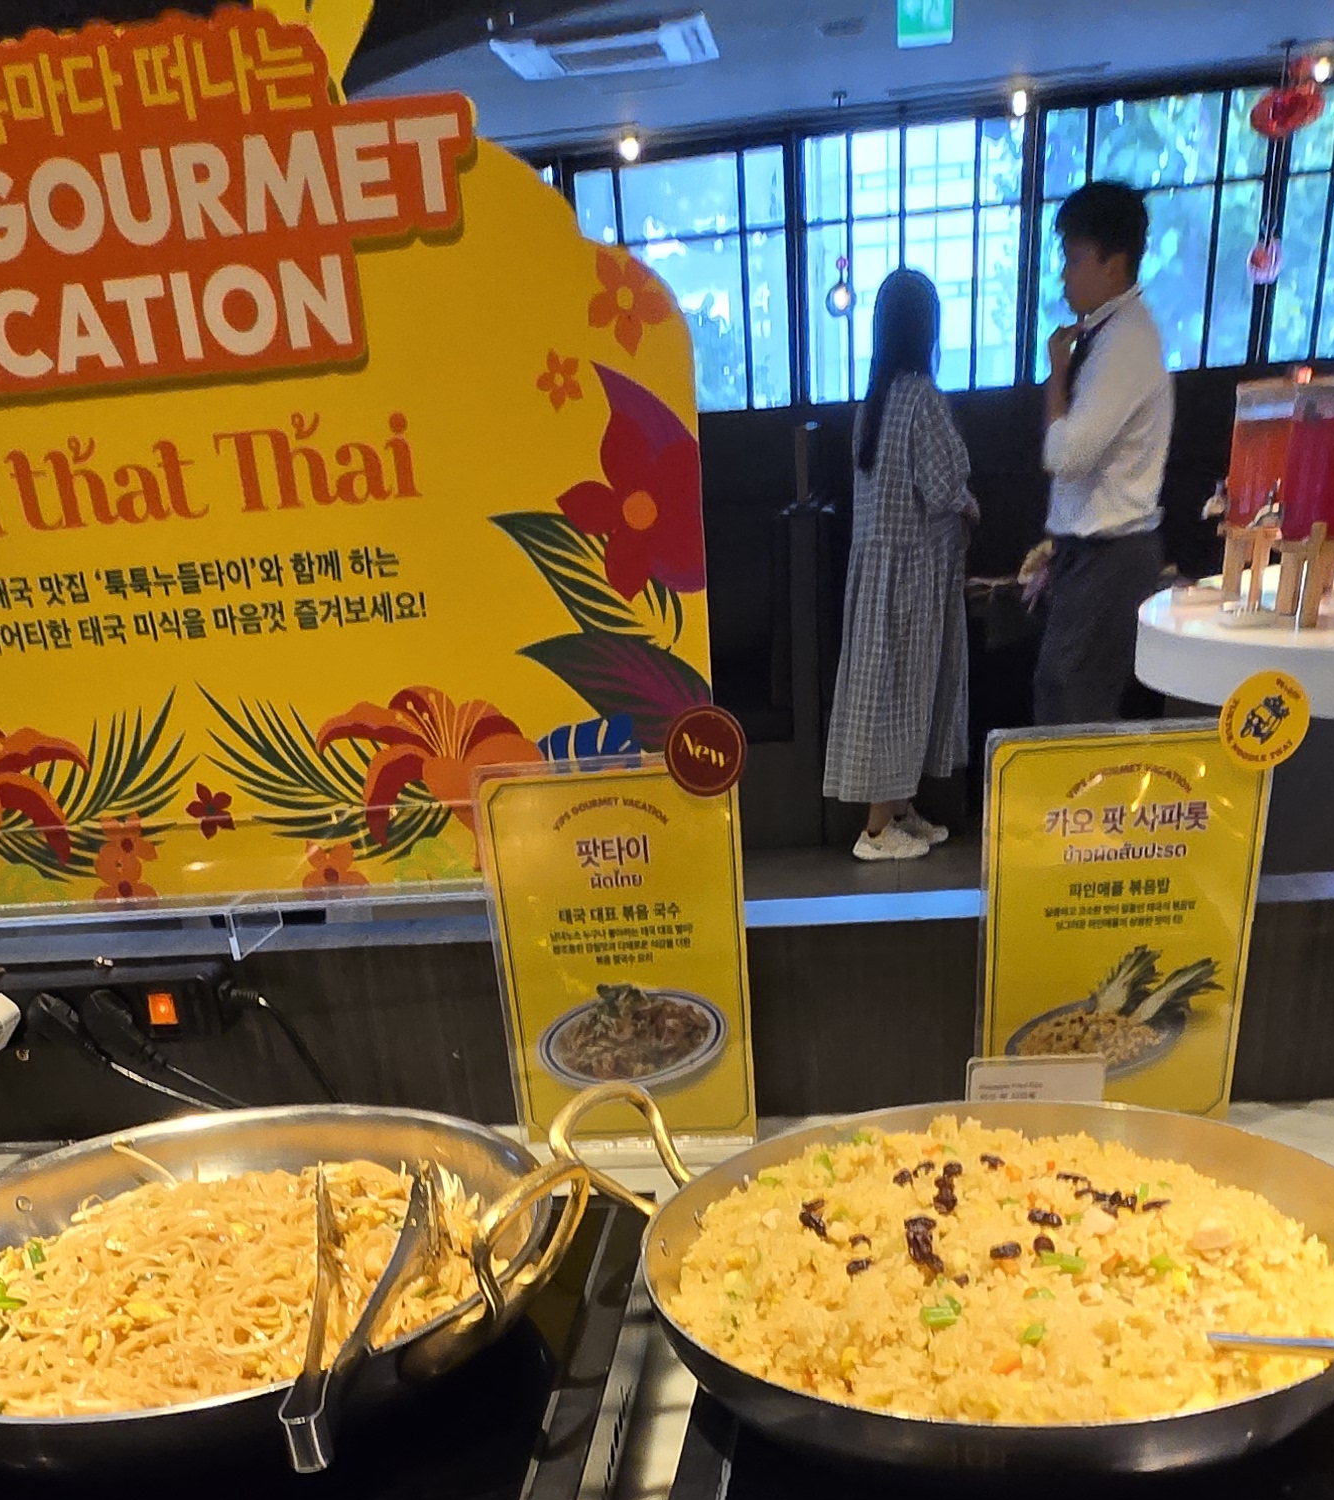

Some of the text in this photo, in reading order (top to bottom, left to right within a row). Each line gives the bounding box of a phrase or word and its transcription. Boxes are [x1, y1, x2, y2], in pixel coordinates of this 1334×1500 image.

[134, 27, 315, 121] 떠나는
[4, 435, 210, 532] that
[213, 411, 422, 514] Thai
[39, 571, 91, 607] 맛집
[290, 549, 342, 586] 함께
[349, 546, 400, 580] 하는
[77, 613, 127, 647] 태국
[133, 606, 207, 642] 미식을
[212, 600, 288, 636] 마음껏
[294, 591, 427, 630] 즐겨보세요!
[679, 732, 731, 768] New
[622, 797, 670, 826] VACATION
[1045, 800, 1209, 837] 카오 팟 사파롯
[576, 834, 650, 868] 팟타이
[558, 902, 680, 925] 태국 대표 볶음 국수
